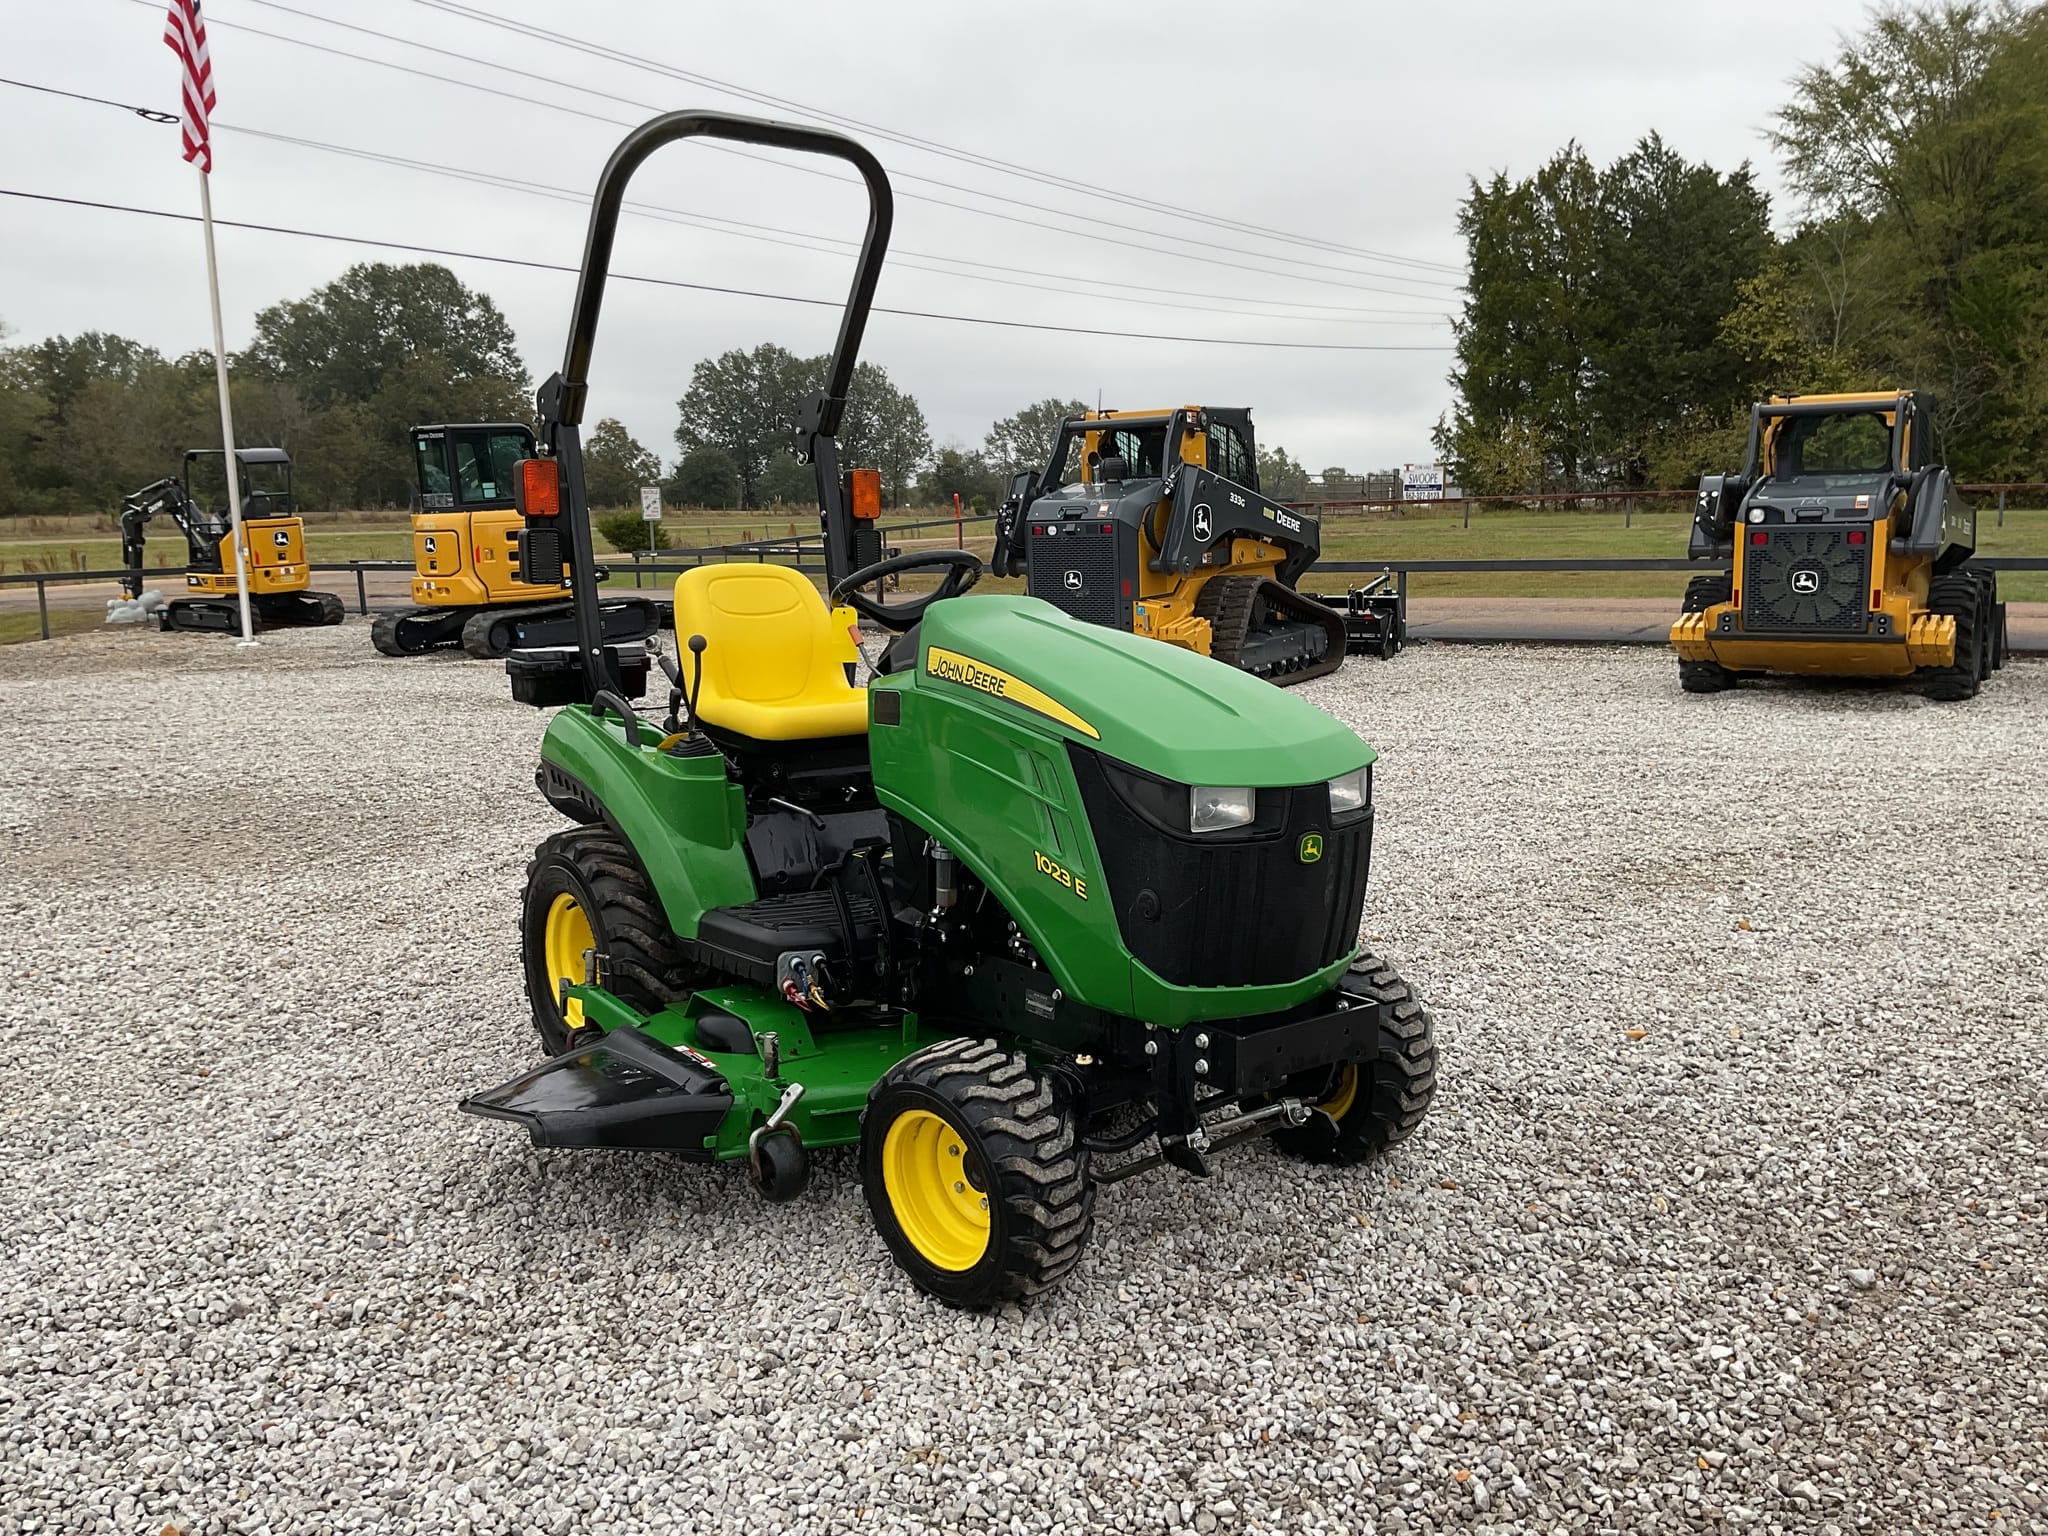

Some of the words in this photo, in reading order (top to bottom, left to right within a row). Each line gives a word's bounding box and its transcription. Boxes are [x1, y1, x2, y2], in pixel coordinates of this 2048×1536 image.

[1408, 472, 1438, 484] SWOOPE
[1229, 492, 1246, 508] 333G
[1276, 509, 1301, 533] DEERE
[932, 655, 964, 681] JOHN
[965, 664, 1007, 695] DEERE
[1033, 850, 1072, 888] 1023
[1073, 876, 1088, 901] E
